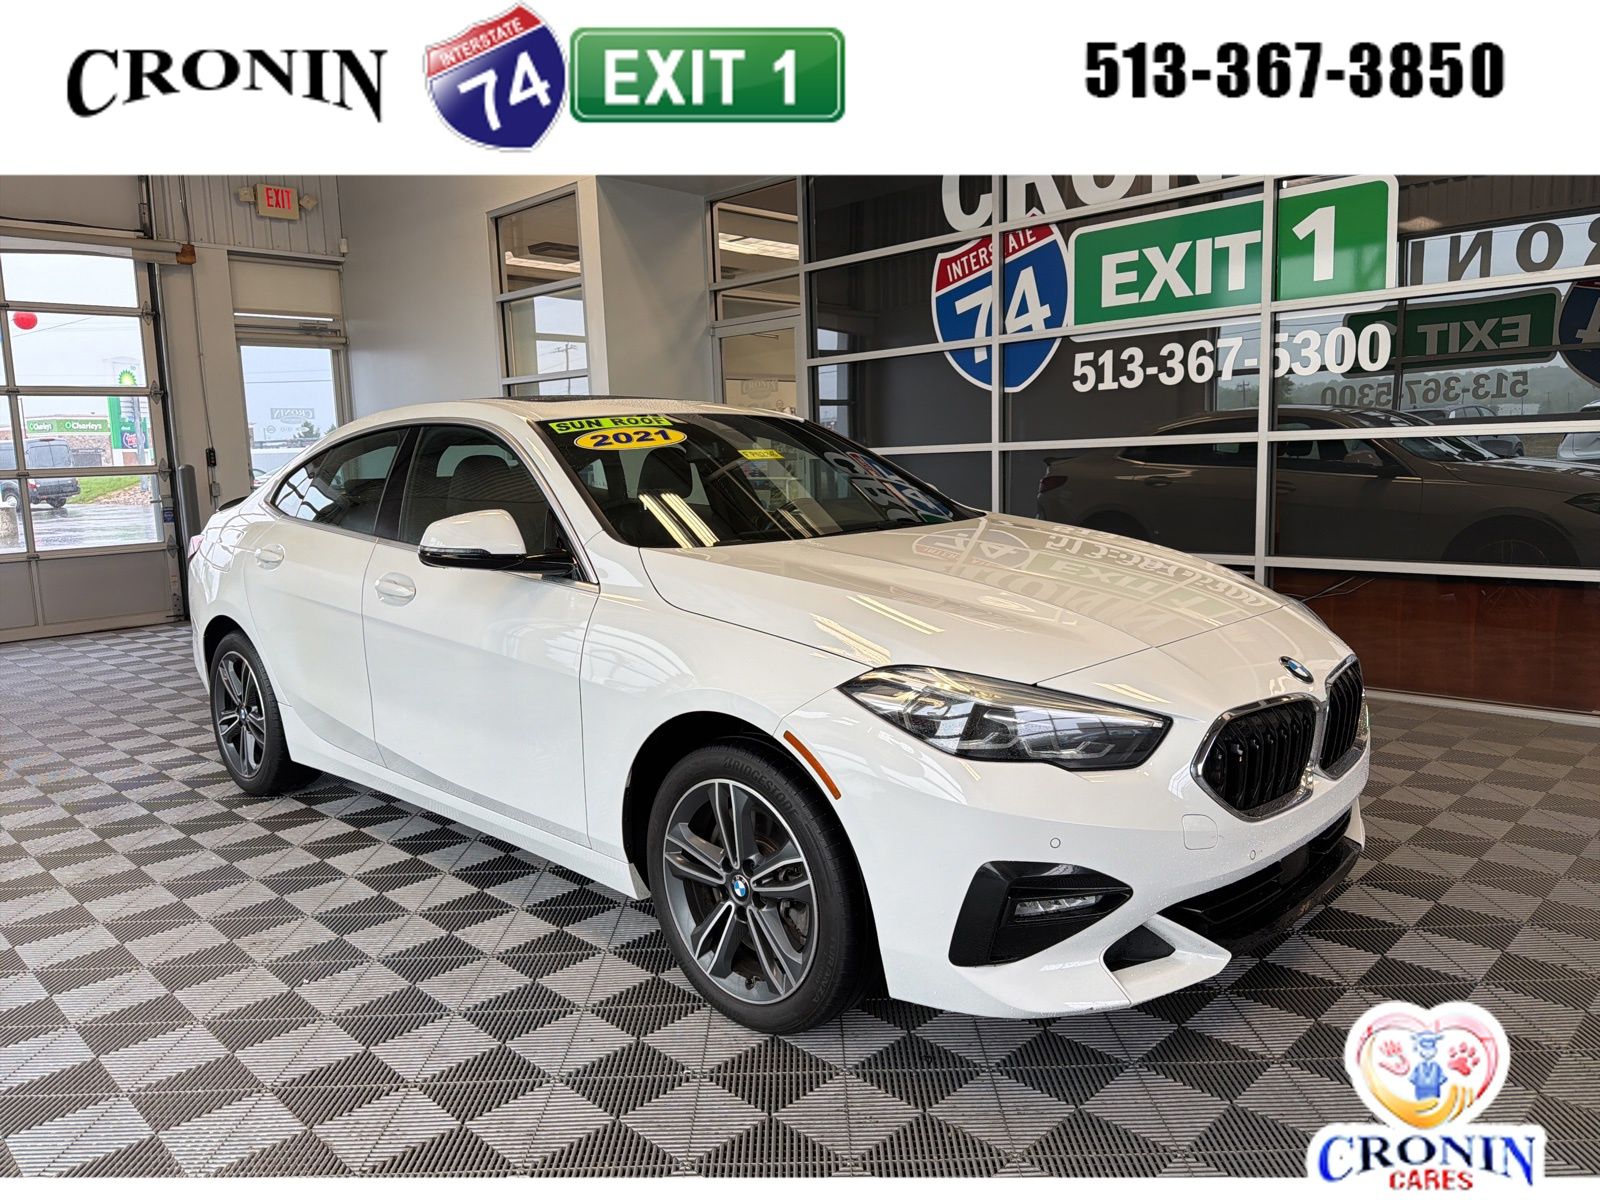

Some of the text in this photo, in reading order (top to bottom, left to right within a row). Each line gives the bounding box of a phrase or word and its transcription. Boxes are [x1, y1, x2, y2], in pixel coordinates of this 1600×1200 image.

[265, 187, 292, 210] EXIT
[946, 229, 1037, 283] INTERSATE
[1101, 205, 1336, 309] EXIT 1
[954, 265, 1052, 364] 74
[1072, 323, 1392, 393] 513-367-5300
[555, 416, 667, 432] SUN ROOF
[590, 429, 672, 447] 2021
